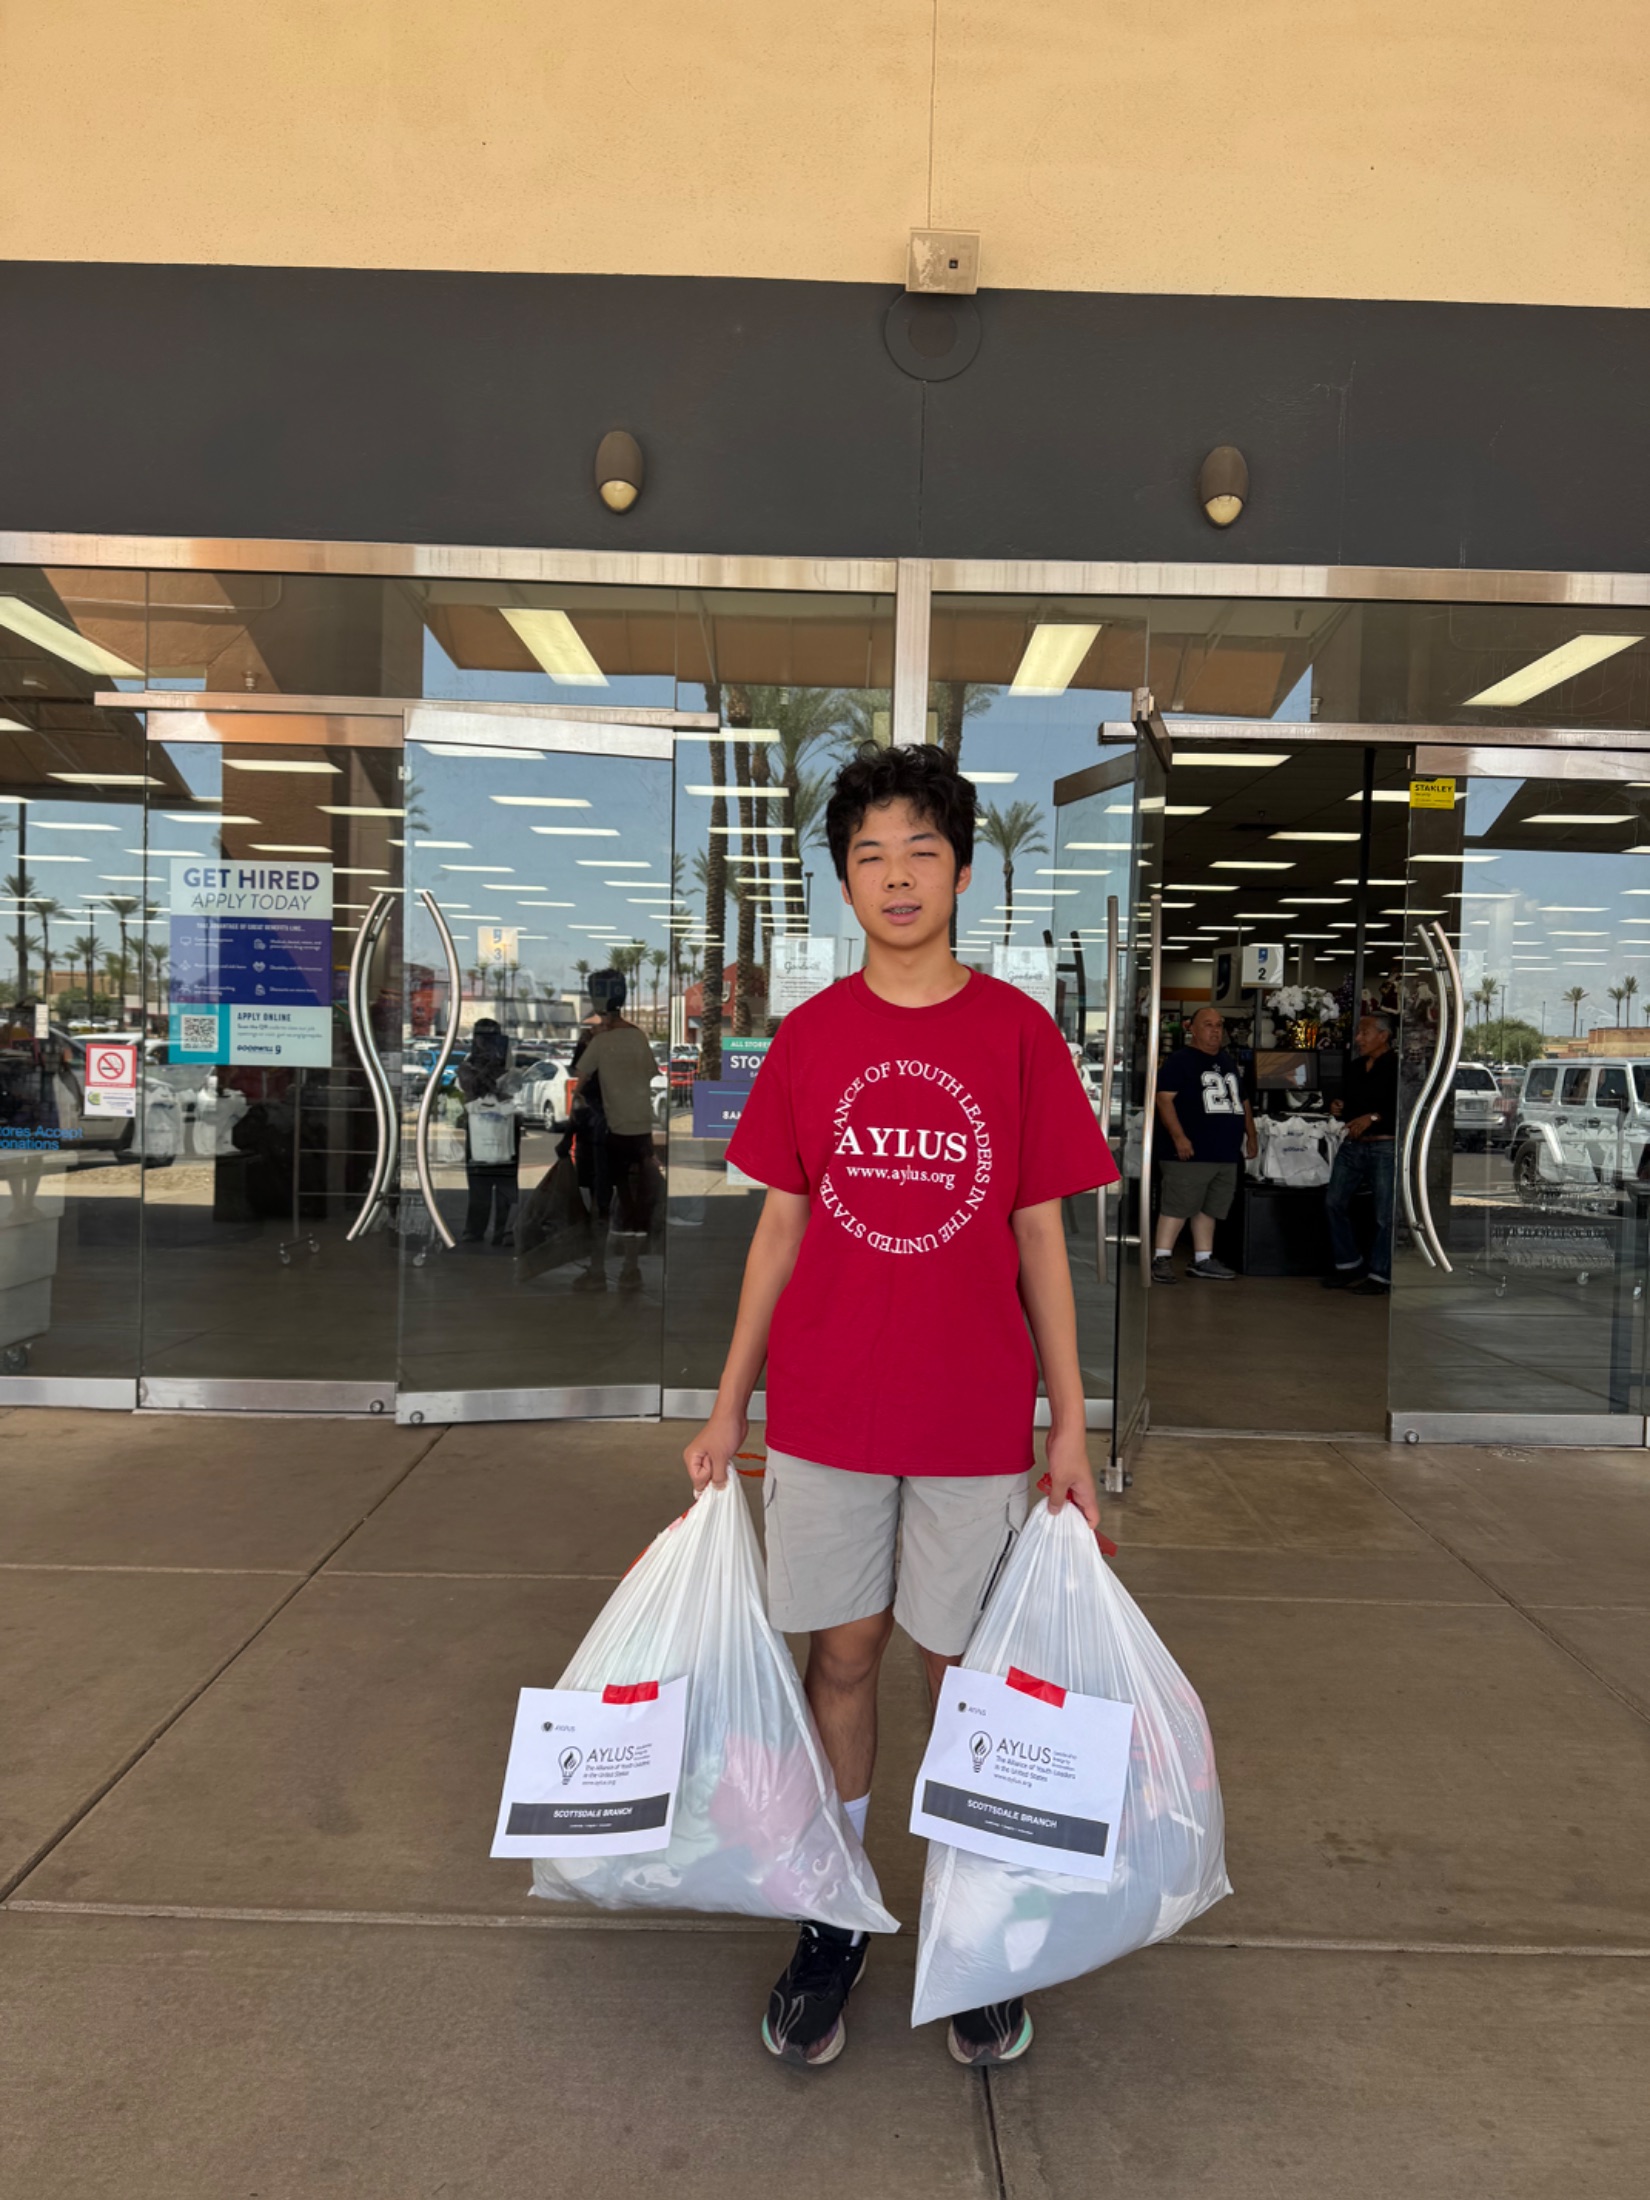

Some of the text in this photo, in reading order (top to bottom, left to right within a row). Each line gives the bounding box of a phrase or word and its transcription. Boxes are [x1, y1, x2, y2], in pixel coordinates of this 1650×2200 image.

[1415, 784, 1453, 793] STANLEY
[183, 867, 320, 891] GET HIRED
[190, 892, 312, 911] APPLY TODAY
[493, 947, 502, 961] 3
[1258, 967, 1267, 981] 2
[237, 1012, 292, 1022] APPLY ONLINE
[744, 1041, 771, 1049] STORE
[730, 1055, 766, 1069] STO
[864, 1061, 891, 1083] OF
[896, 1059, 964, 1098] YOUTH
[1201, 1071, 1245, 1115] 21
[34, 1125, 83, 1139] Accept
[958, 1093, 992, 1184] LEADERS
[0, 1139, 59, 1150] onations
[834, 1125, 968, 1163] AYLUS
[846, 1165, 956, 1191] www.aylus.org
[965, 1185, 987, 1210] IN
[938, 1209, 973, 1243] THE
[867, 1231, 939, 1255] UNITED
[586, 1745, 635, 1763] AYLUS
[997, 1738, 1052, 1764] AYLUS
[553, 1807, 633, 1819] SCOTTSDALE BRANCH
[967, 1799, 1020, 1821] SCOTTSDALE
[1020, 1813, 1058, 1829] BRANCH
